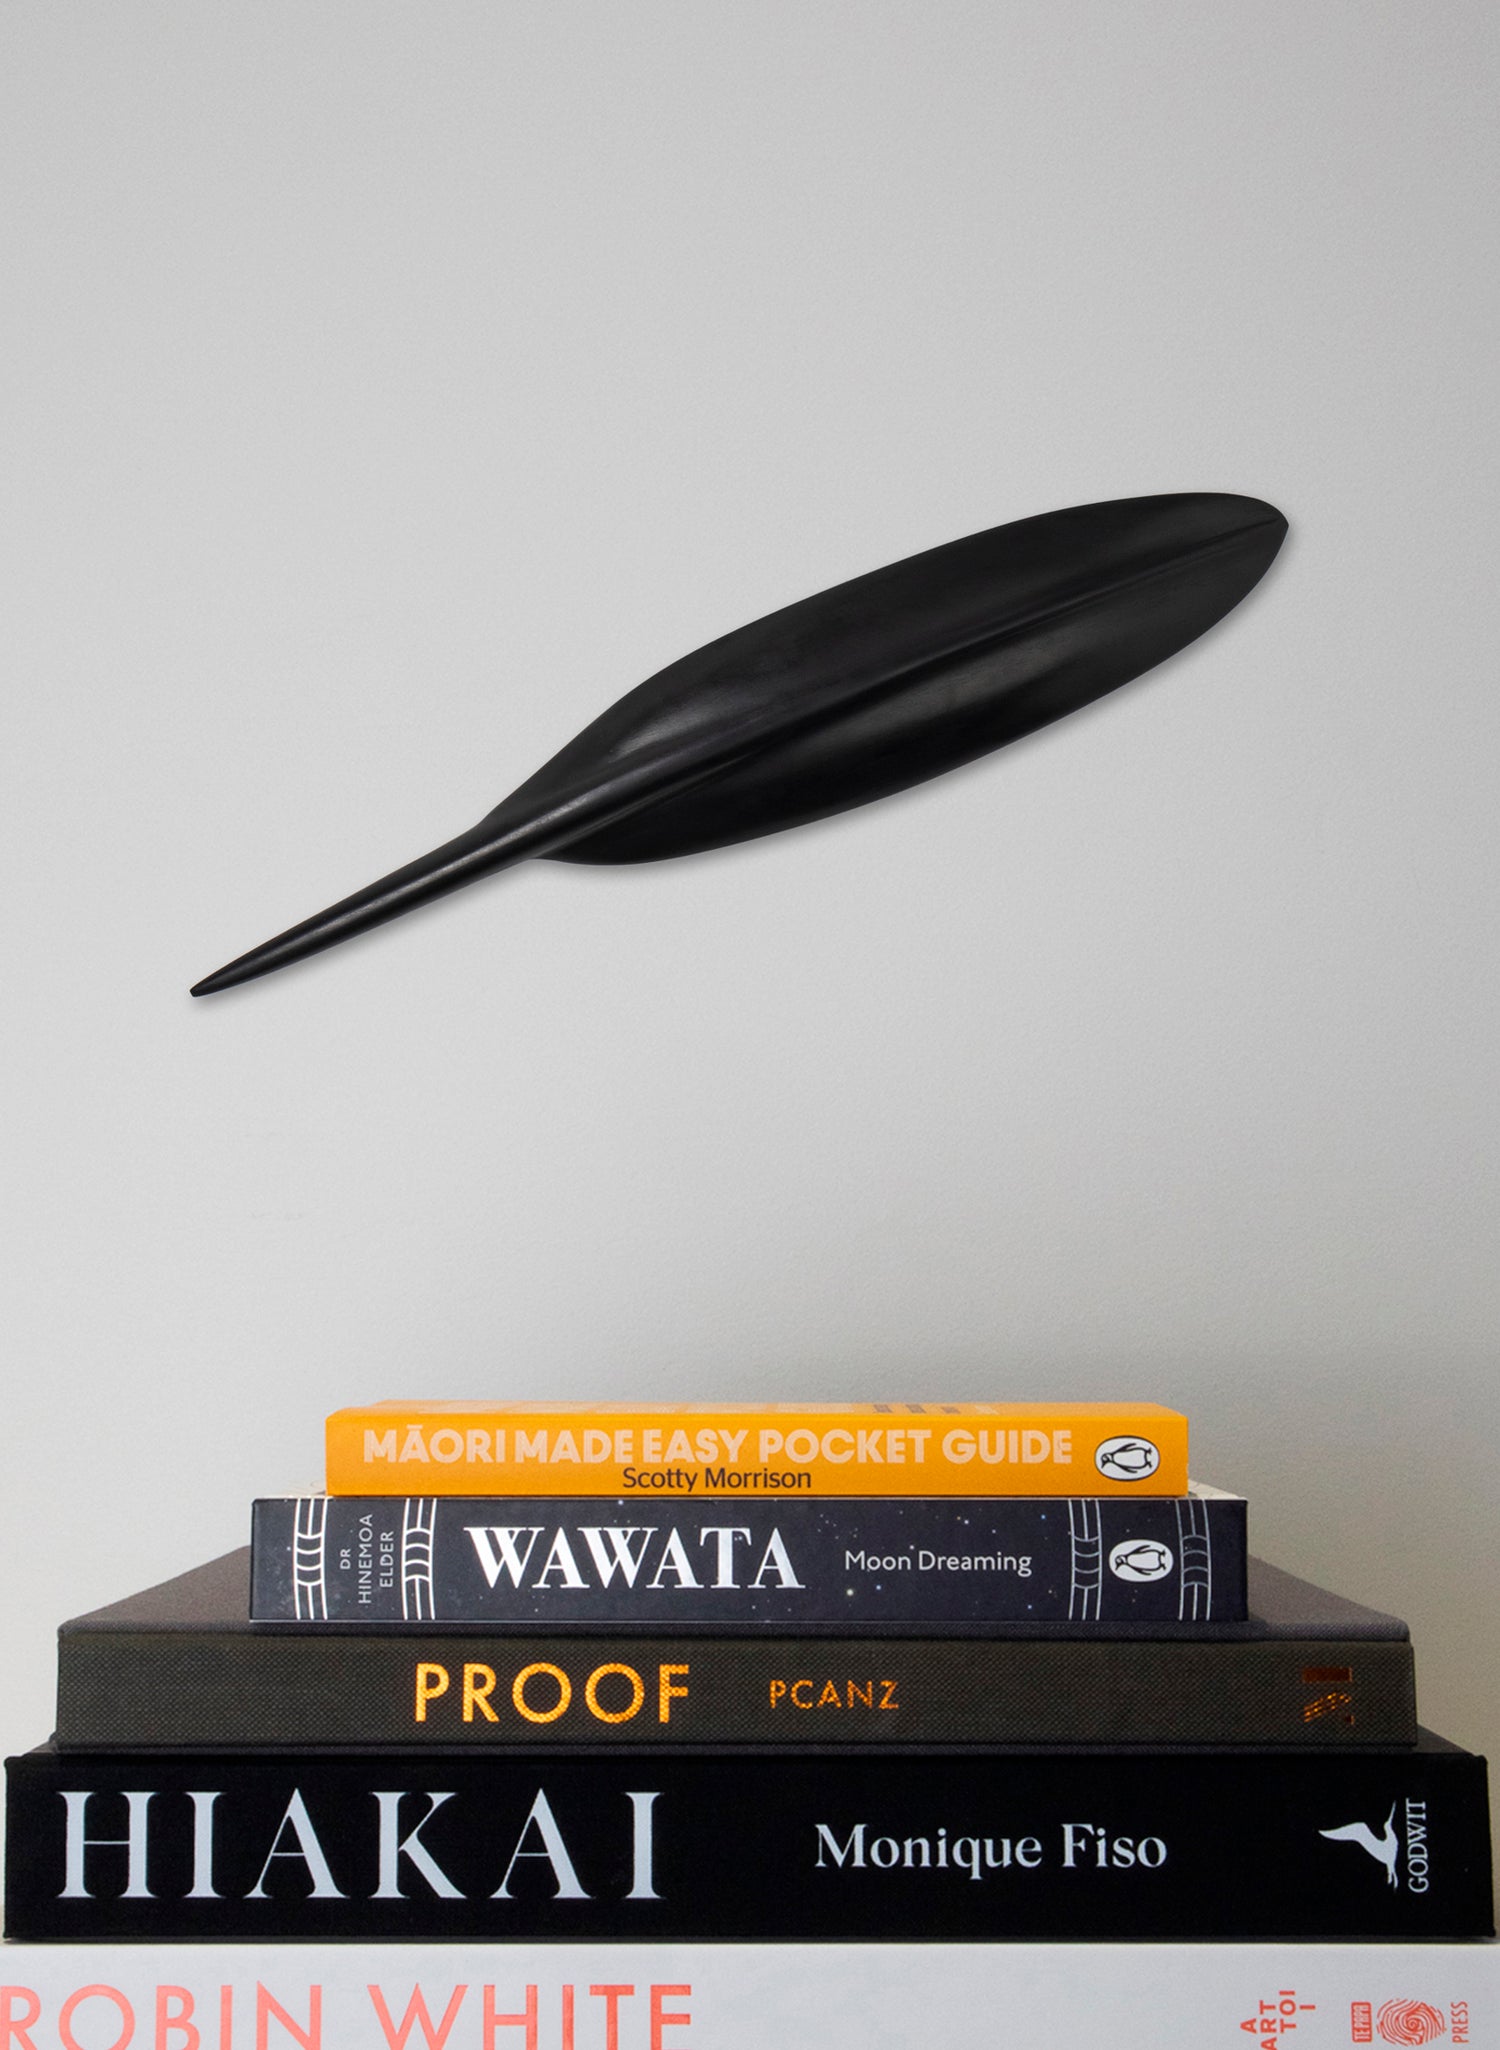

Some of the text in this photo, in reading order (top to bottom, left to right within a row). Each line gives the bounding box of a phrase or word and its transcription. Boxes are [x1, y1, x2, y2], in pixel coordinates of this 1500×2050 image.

[364, 1424, 1071, 1463] MĀORI MADE EASY POCKET GUIDE
[624, 1468, 810, 1491] Scotty Morrison
[340, 1549, 351, 1569] DR
[358, 1514, 372, 1603] HINEMOA
[380, 1531, 394, 1587] ELDER
[463, 1527, 805, 1588] WAWATA
[845, 1550, 1031, 1577] Moon Dreaming
[415, 1662, 689, 1724] PROOF
[770, 1680, 898, 1709] PCANZ
[58, 1789, 663, 1898] HIAKAI
[816, 1824, 1166, 1879] Monique Fiso
[1407, 1799, 1428, 1892] GODWIT
[0, 1982, 691, 2050] ROBIN WHITE
[1353, 2028, 1370, 2041] TE
[1451, 2002, 1468, 2043] PRESS
